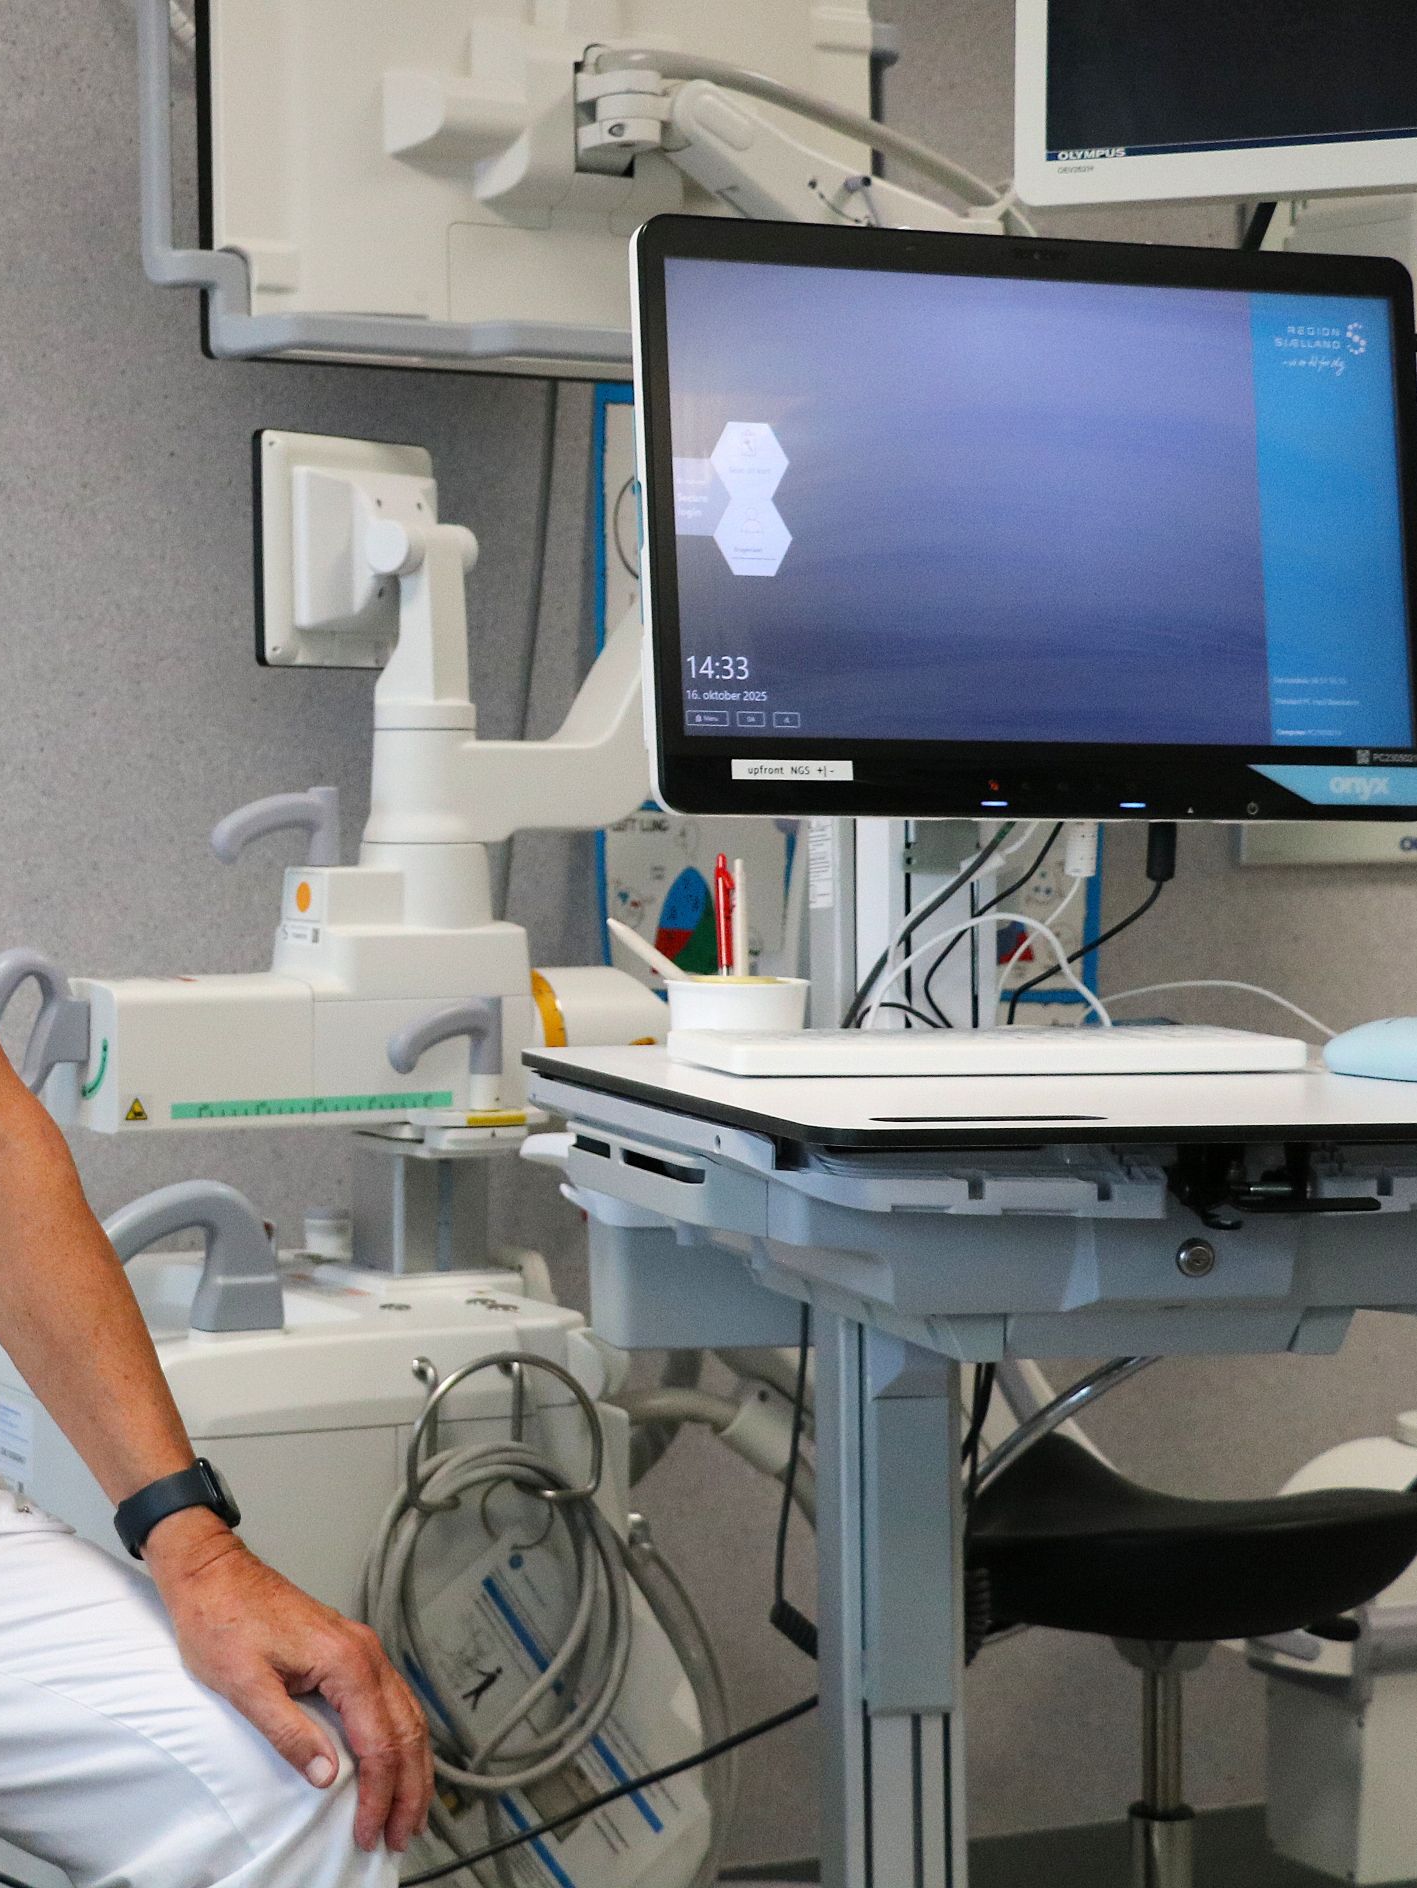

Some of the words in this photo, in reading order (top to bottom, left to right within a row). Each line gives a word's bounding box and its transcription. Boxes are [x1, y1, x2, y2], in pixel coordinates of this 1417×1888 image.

[1057, 147, 1126, 161] OLYMPUS
[1287, 325, 1342, 337] REGION
[686, 655, 750, 680] 14:33
[686, 689, 702, 700] 16.
[703, 689, 741, 700] oktober
[743, 690, 768, 702] 2025
[747, 765, 784, 776] upfront
[790, 766, 810, 775] NGS
[1329, 776, 1390, 800] onyx
